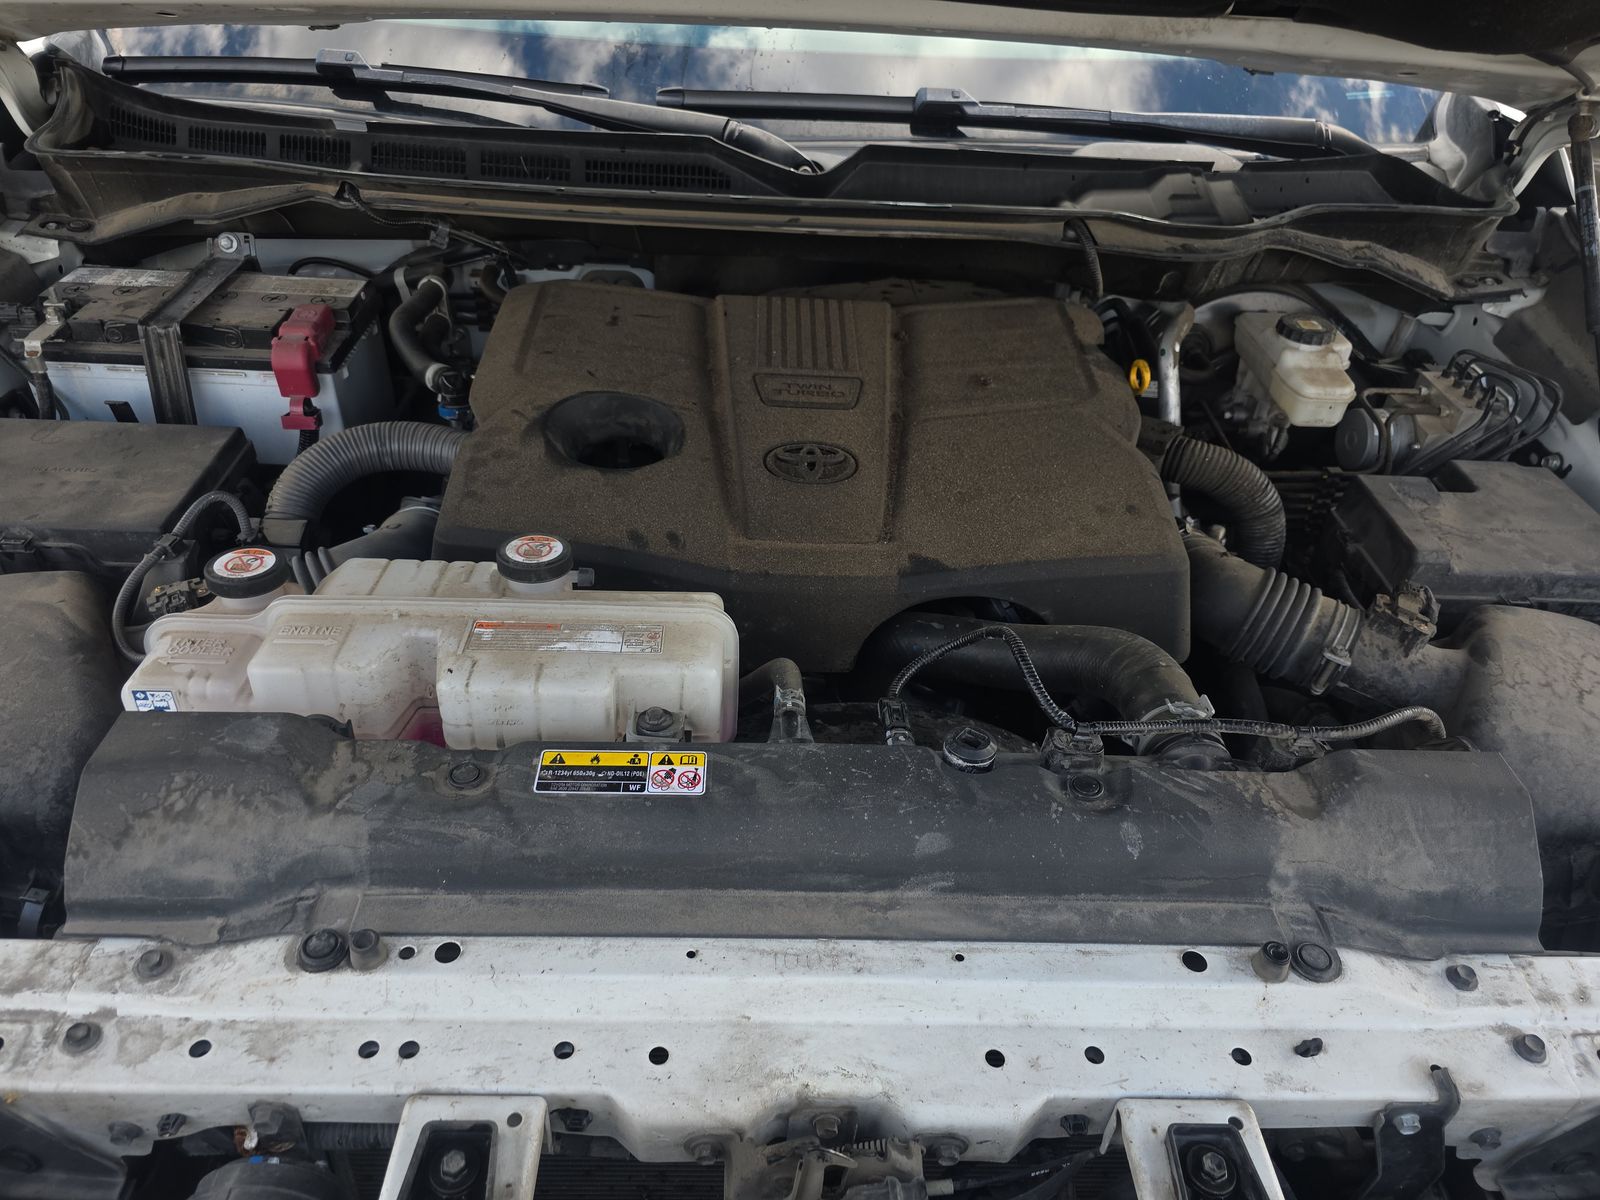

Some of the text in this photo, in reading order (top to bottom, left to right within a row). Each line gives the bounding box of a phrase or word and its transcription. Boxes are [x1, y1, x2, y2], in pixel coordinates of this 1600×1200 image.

[782, 382, 832, 390] TWIN
[773, 389, 845, 398] TURBO
[278, 624, 343, 636] ENGINE
[174, 638, 227, 647] INTER
[168, 646, 234, 656] COOLER
